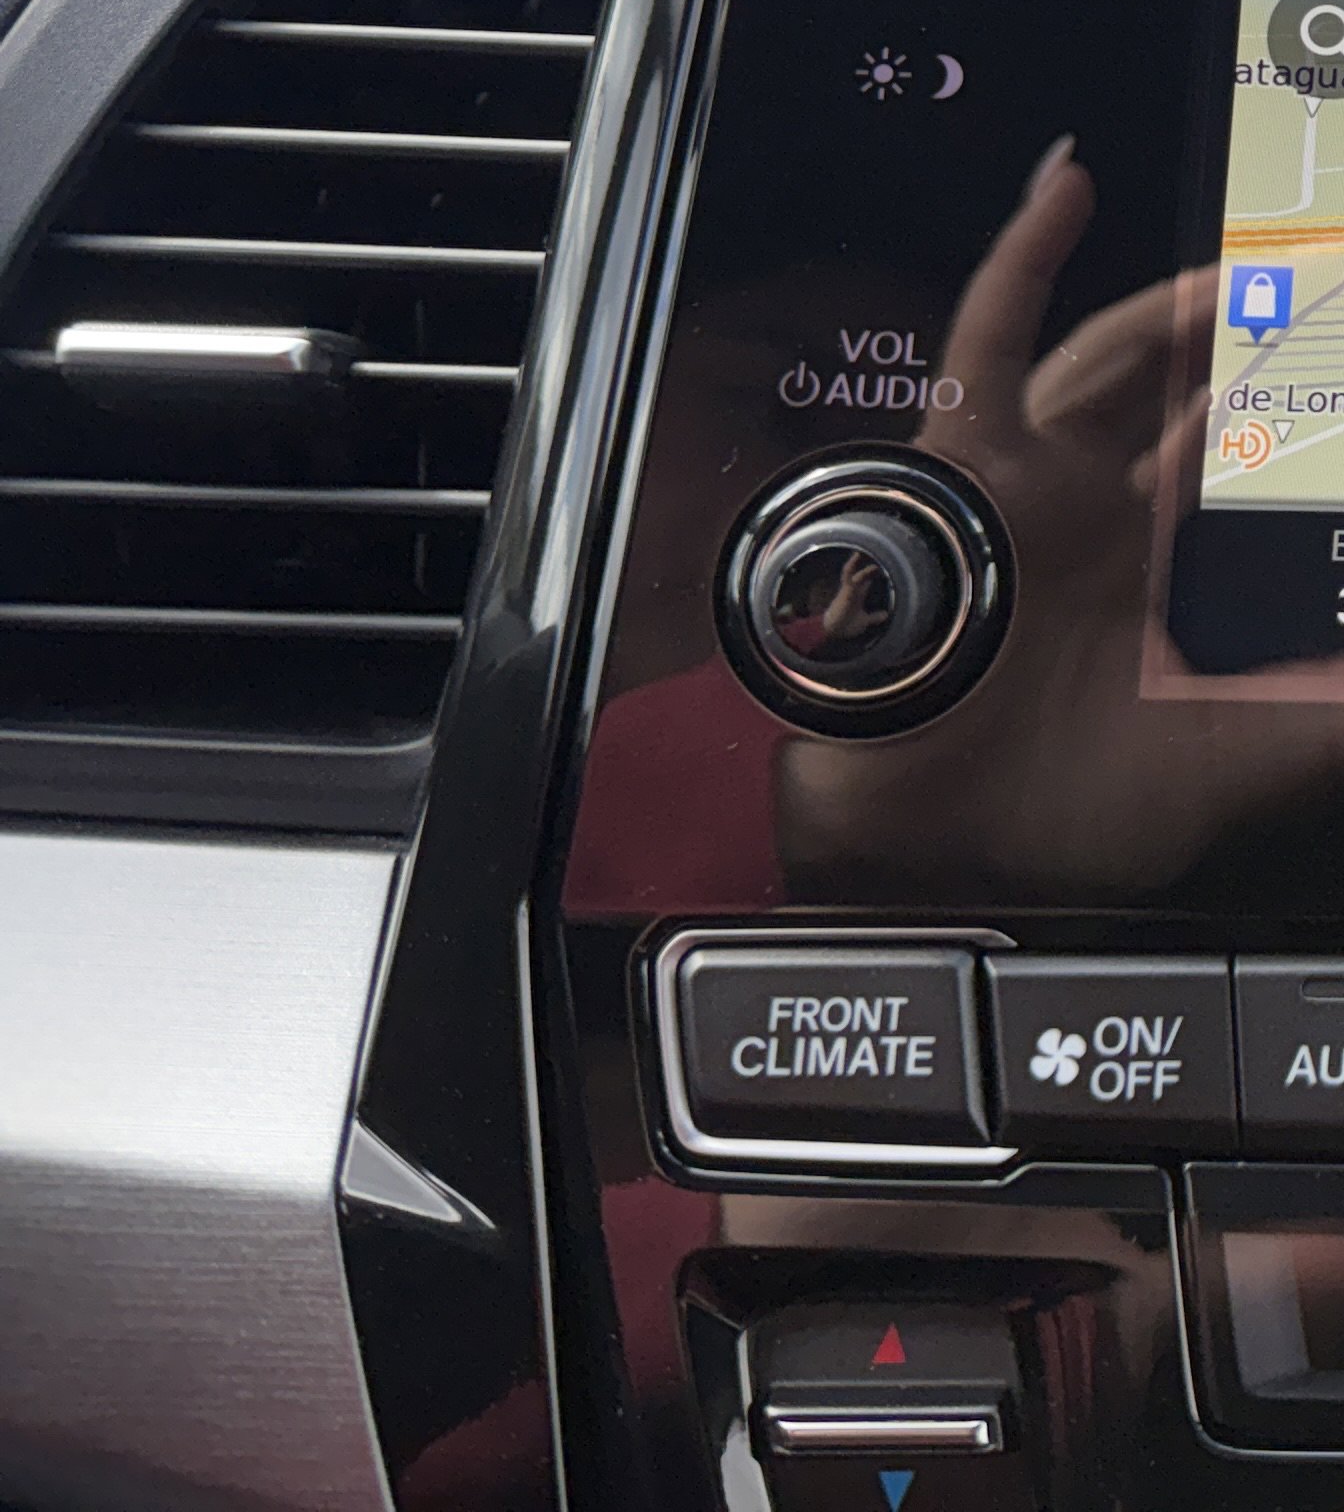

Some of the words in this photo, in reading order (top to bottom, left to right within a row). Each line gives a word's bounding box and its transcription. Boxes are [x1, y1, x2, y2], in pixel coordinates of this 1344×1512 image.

[839, 329, 927, 367] VOL
[824, 372, 964, 411] AUDIO
[1229, 384, 1272, 412] de
[767, 996, 907, 1034] FRONT
[1092, 1016, 1181, 1056] ON/
[731, 1036, 934, 1077] CLIMATE
[1090, 1058, 1181, 1101] OFF
